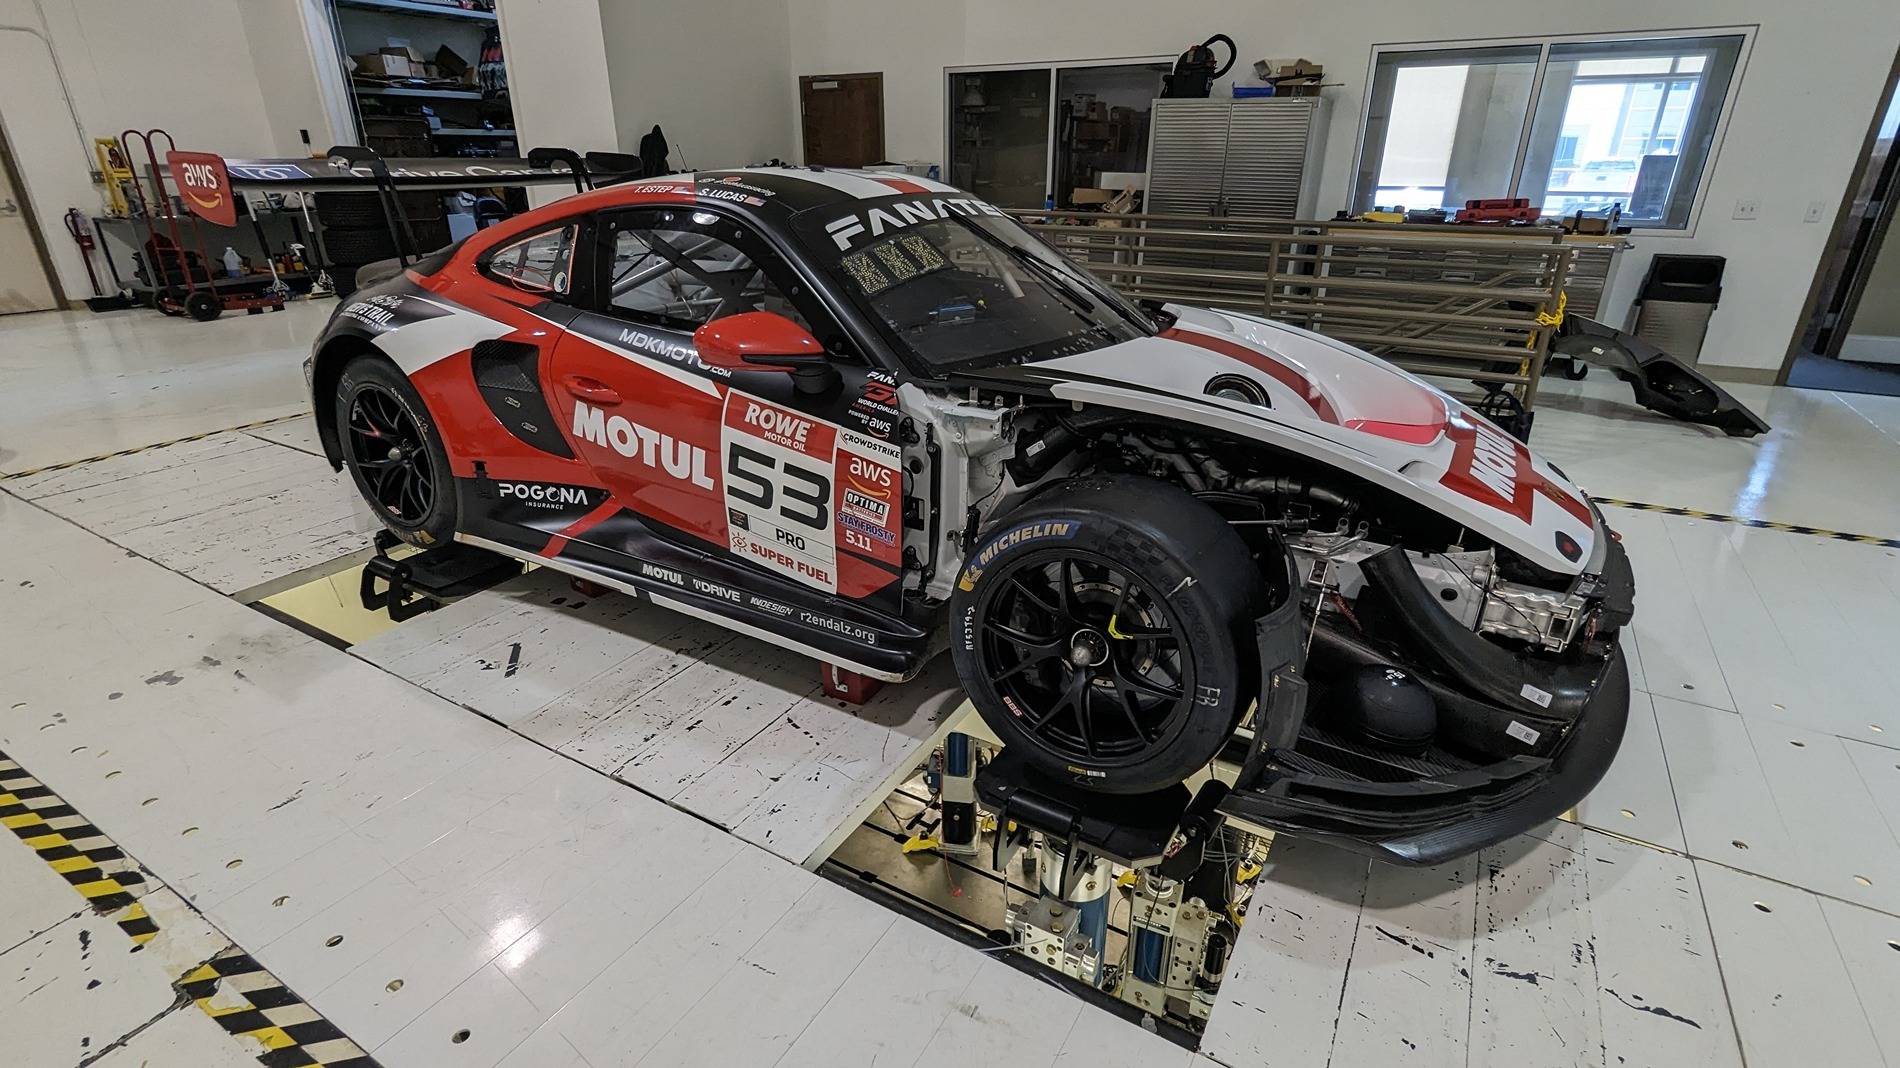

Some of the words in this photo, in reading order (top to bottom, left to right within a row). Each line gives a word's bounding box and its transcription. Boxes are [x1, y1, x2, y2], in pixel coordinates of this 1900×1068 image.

[182, 163, 217, 190] aws
[866, 371, 896, 386] FAN
[847, 409, 870, 421] POWERED
[857, 397, 877, 409] WORLD
[744, 402, 811, 443] ROWE
[869, 417, 892, 433] aws
[572, 400, 714, 491] MOTUL
[763, 430, 792, 448] MOTOR
[792, 441, 806, 452] OIL
[843, 433, 900, 459] CROWDSTRIKE
[849, 457, 892, 487] aws
[1469, 424, 1518, 504] MOTUL
[498, 483, 589, 506] POGONA
[727, 441, 831, 531] 53
[525, 501, 564, 510] INSURANCE
[847, 492, 886, 515] OPTIMA
[837, 512, 860, 528] STAY
[860, 520, 896, 542] FROSTY
[775, 528, 806, 551] PRO
[845, 529, 872, 552] 5.11
[979, 523, 1070, 565] MICHELIN
[750, 542, 795, 570] SUPER
[797, 561, 833, 586] FUEL
[642, 563, 684, 586] MOTUL
[800, 611, 876, 645] r2endalz.org
[1003, 696, 1023, 717] BBS
